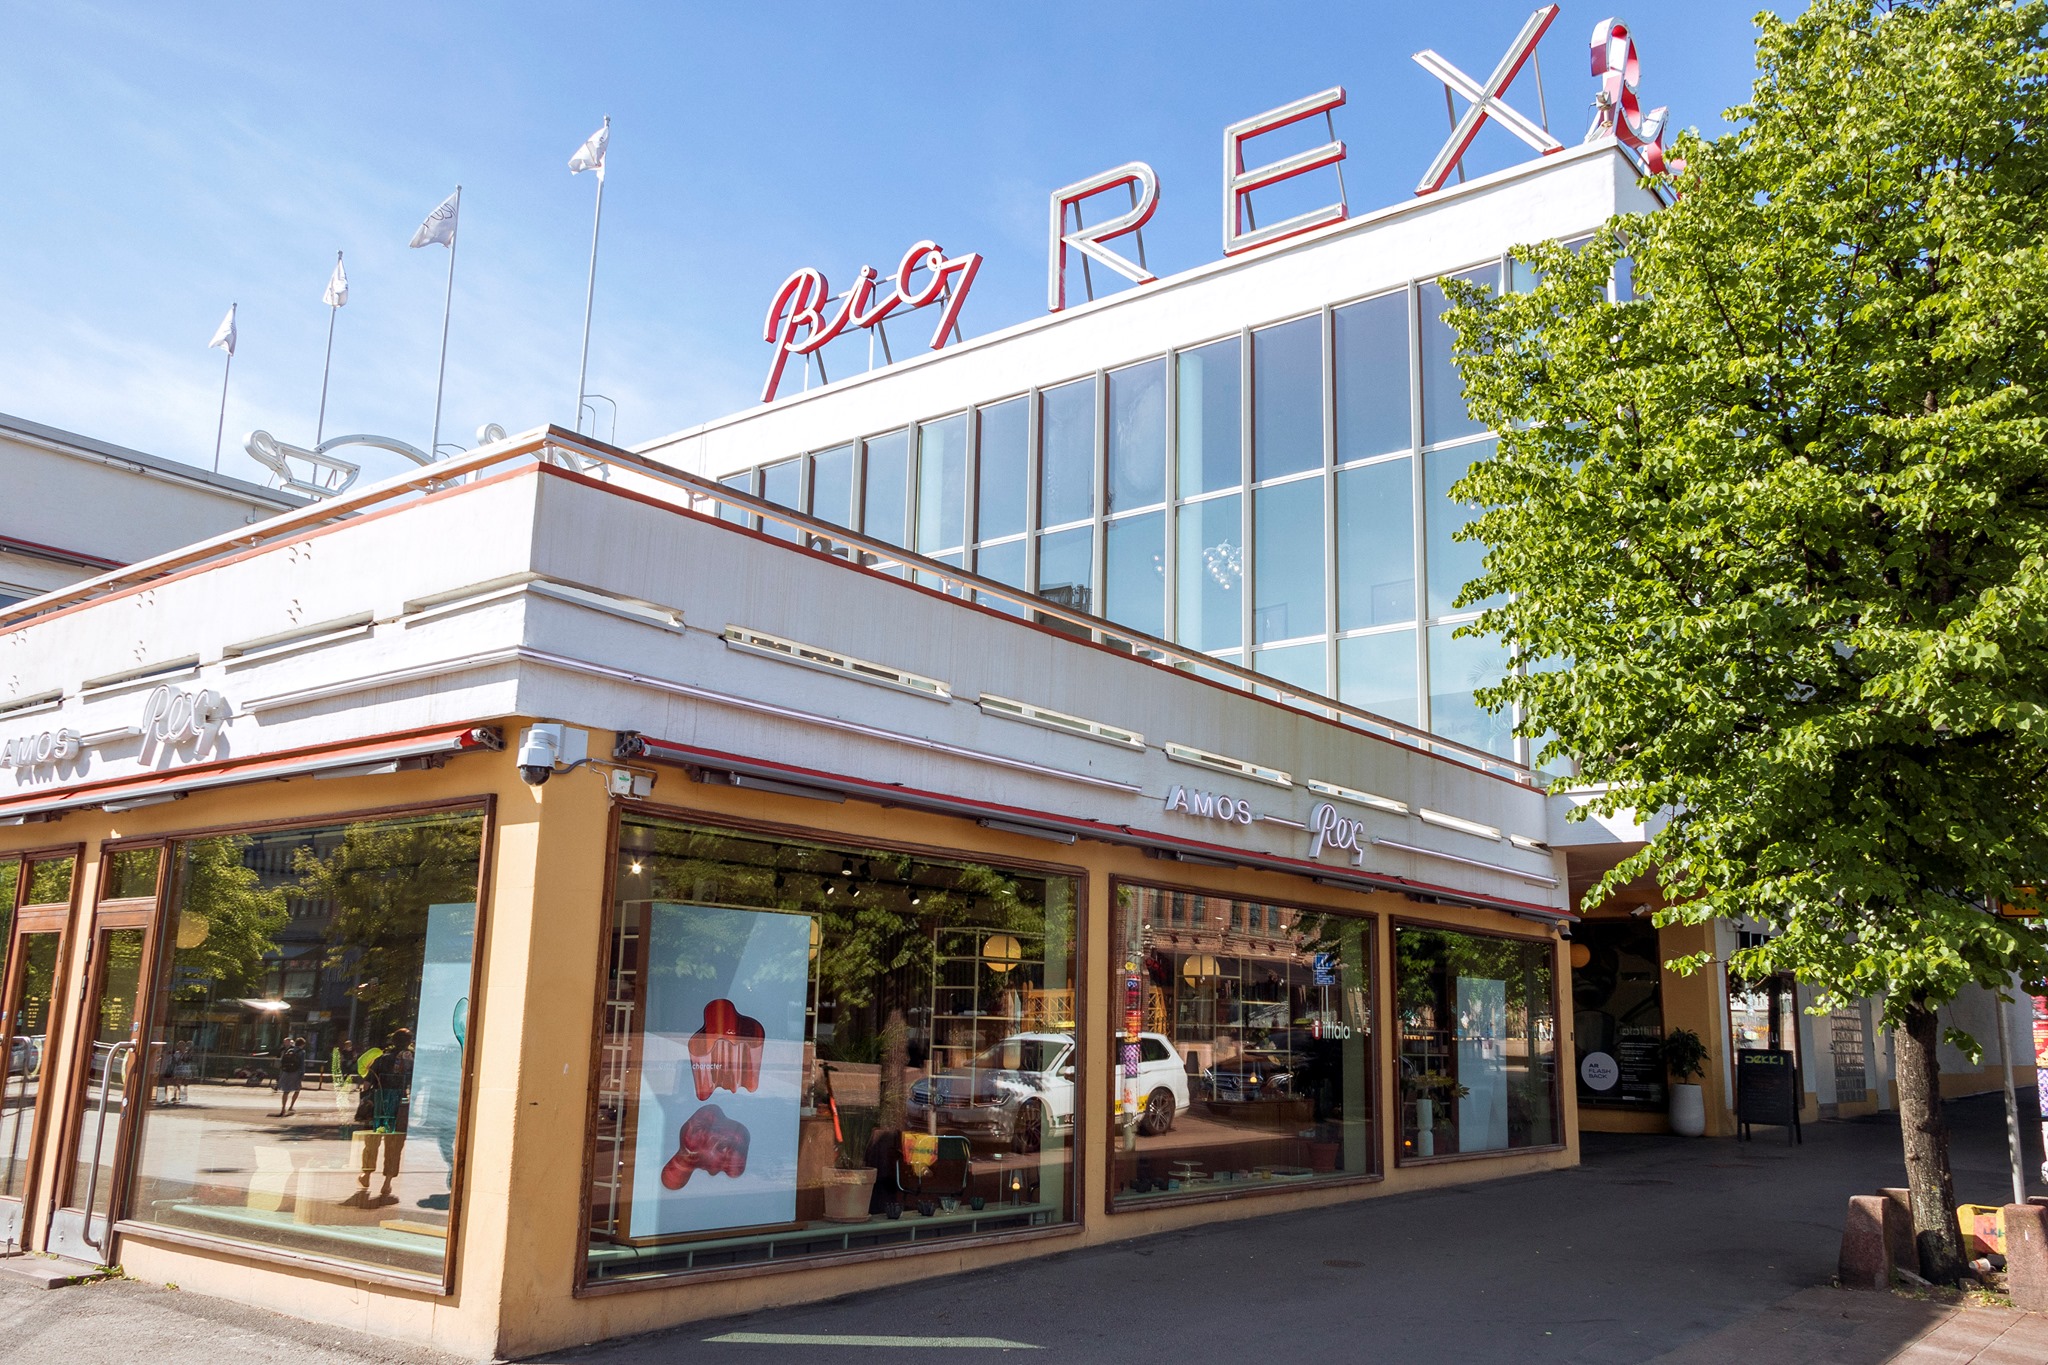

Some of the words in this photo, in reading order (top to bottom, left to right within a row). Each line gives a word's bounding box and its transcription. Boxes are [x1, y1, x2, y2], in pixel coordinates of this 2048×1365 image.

[760, 239, 984, 404] Bio
[1047, 4, 1563, 312] REX
[0, 728, 80, 769] AMOS
[137, 683, 221, 767] Rex
[1165, 785, 1252, 825] AMOS
[1309, 802, 1364, 866] Rex
